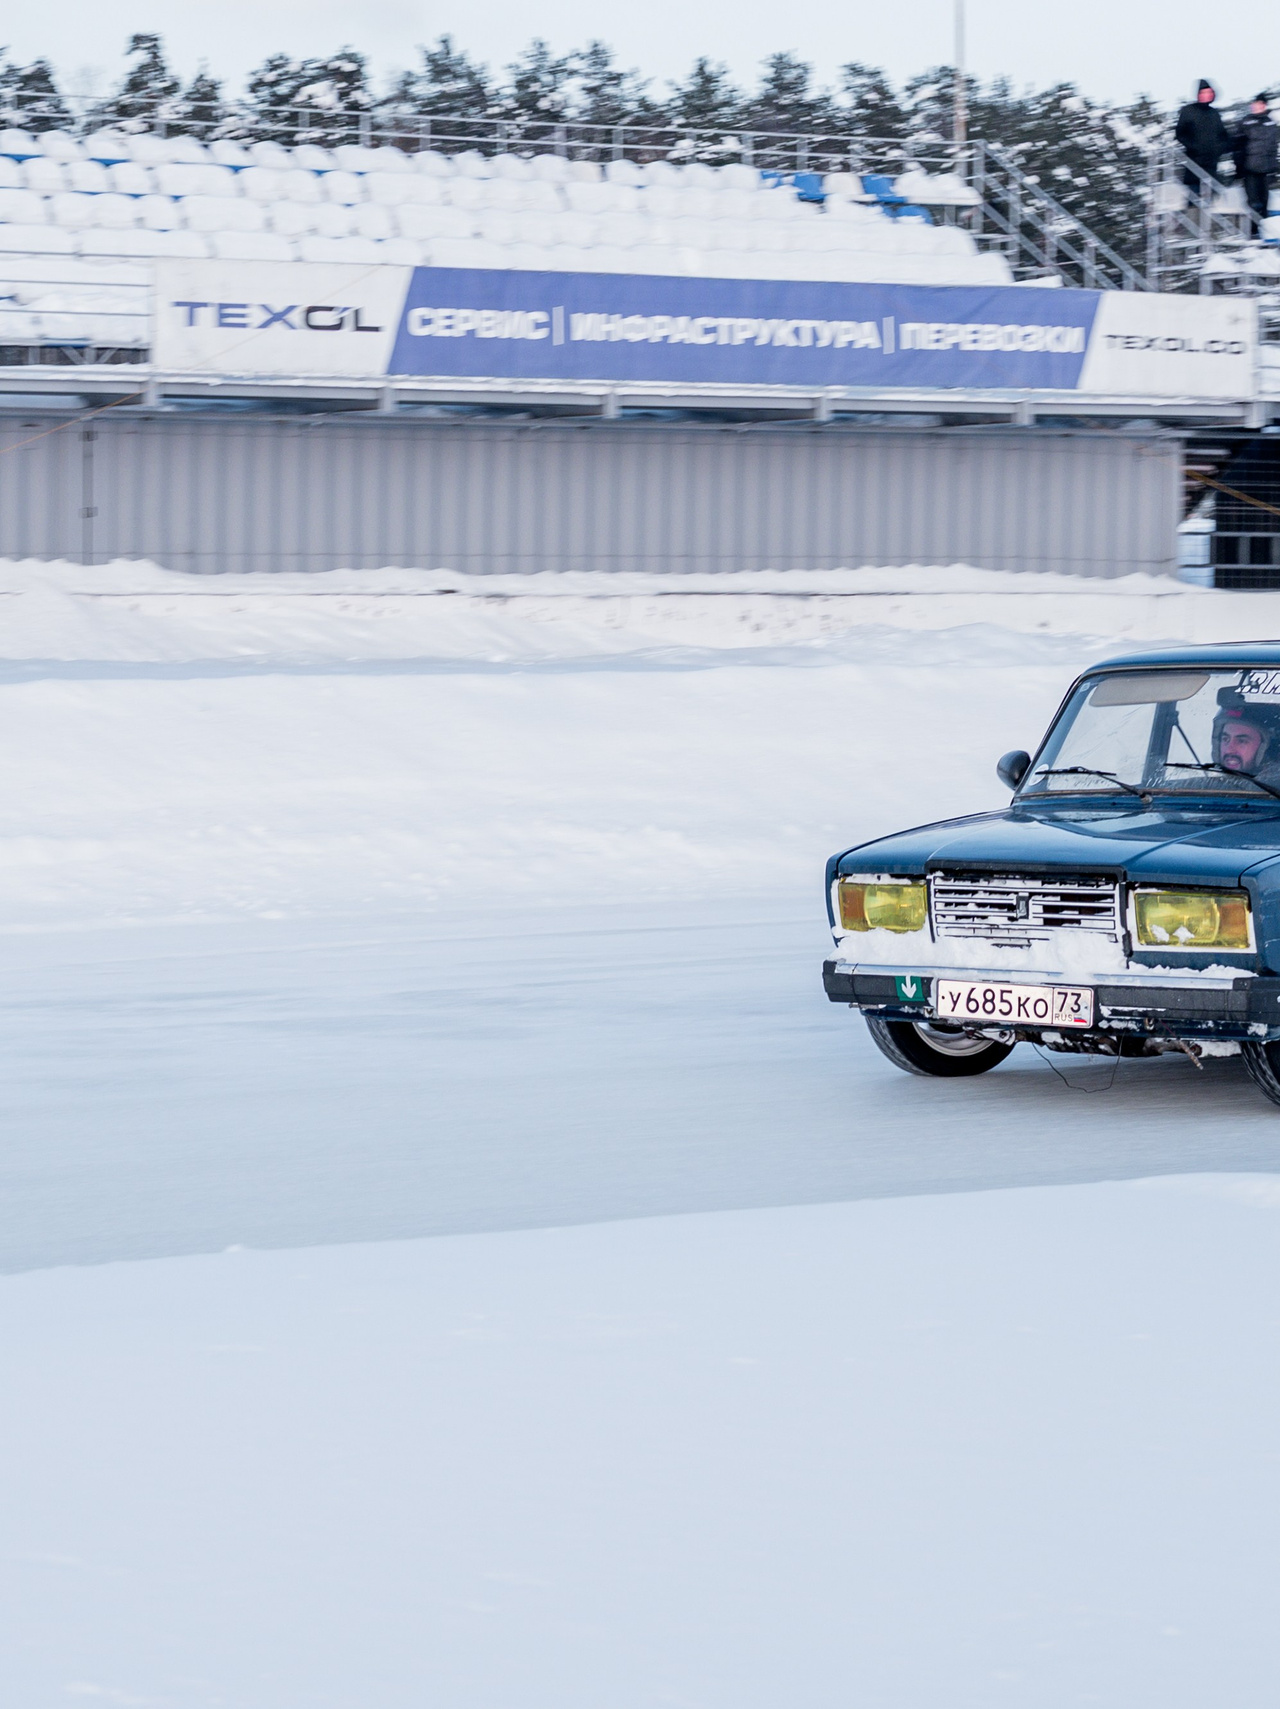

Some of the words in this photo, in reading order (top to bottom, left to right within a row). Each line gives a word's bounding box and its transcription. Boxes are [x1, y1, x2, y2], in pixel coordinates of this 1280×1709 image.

[173, 301, 382, 332] TEXOL
[407, 307, 551, 340] СЕРВИС
[569, 312, 882, 349] ИНФРАСТРУКТУРА
[899, 322, 1086, 353] ПЕРЕВОЗКИ
[1057, 991, 1082, 1013] 73
[1054, 1013, 1073, 1022] RUS
